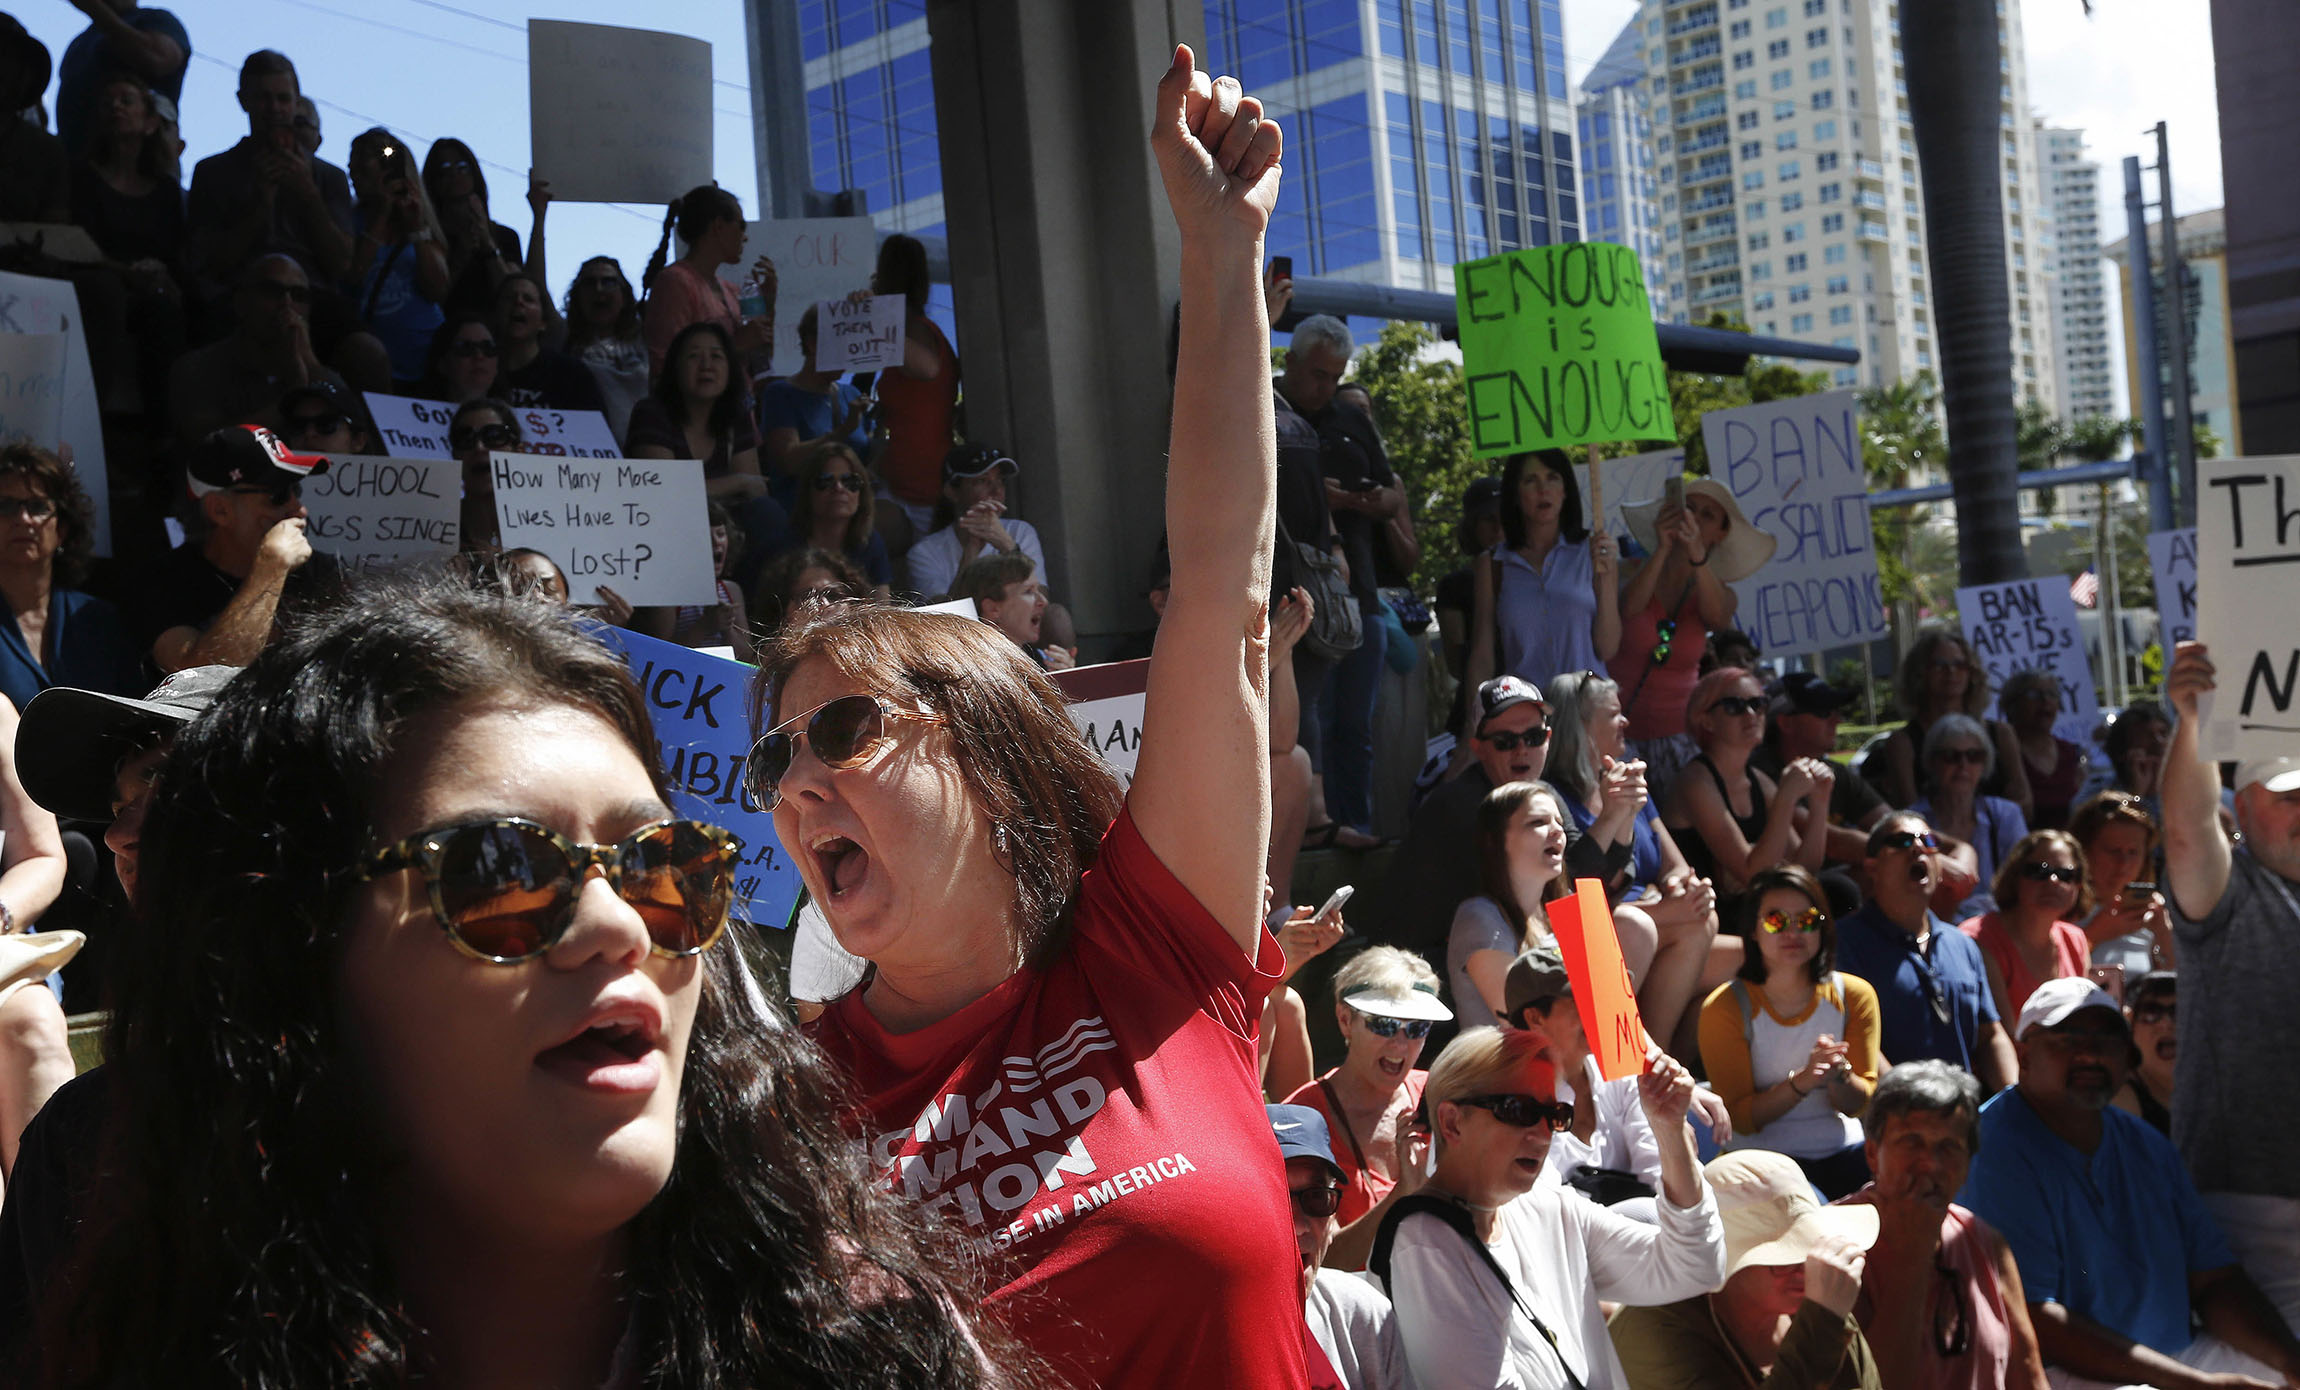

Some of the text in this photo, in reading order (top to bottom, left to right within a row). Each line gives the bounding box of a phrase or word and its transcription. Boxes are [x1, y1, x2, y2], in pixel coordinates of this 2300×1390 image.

[793, 231, 855, 268] OUR
[827, 298, 872, 317] VOTE
[833, 321, 874, 337] THEM
[383, 429, 436, 451] Then
[1724, 410, 1855, 498] BAN
[314, 461, 440, 499] SCHOOL
[558, 463, 601, 493] Many
[617, 465, 662, 487] More
[375, 516, 457, 546] SINCE
[504, 503, 650, 528] Lives Have To
[571, 544, 653, 581] Lost?
[1732, 570, 1885, 651] WEAPONS
[1978, 582, 2043, 622] BAN
[879, 1076, 1107, 1201] MAND
[1032, 1203, 1065, 1233] IN
[1072, 1152, 1197, 1218] AMERICA
